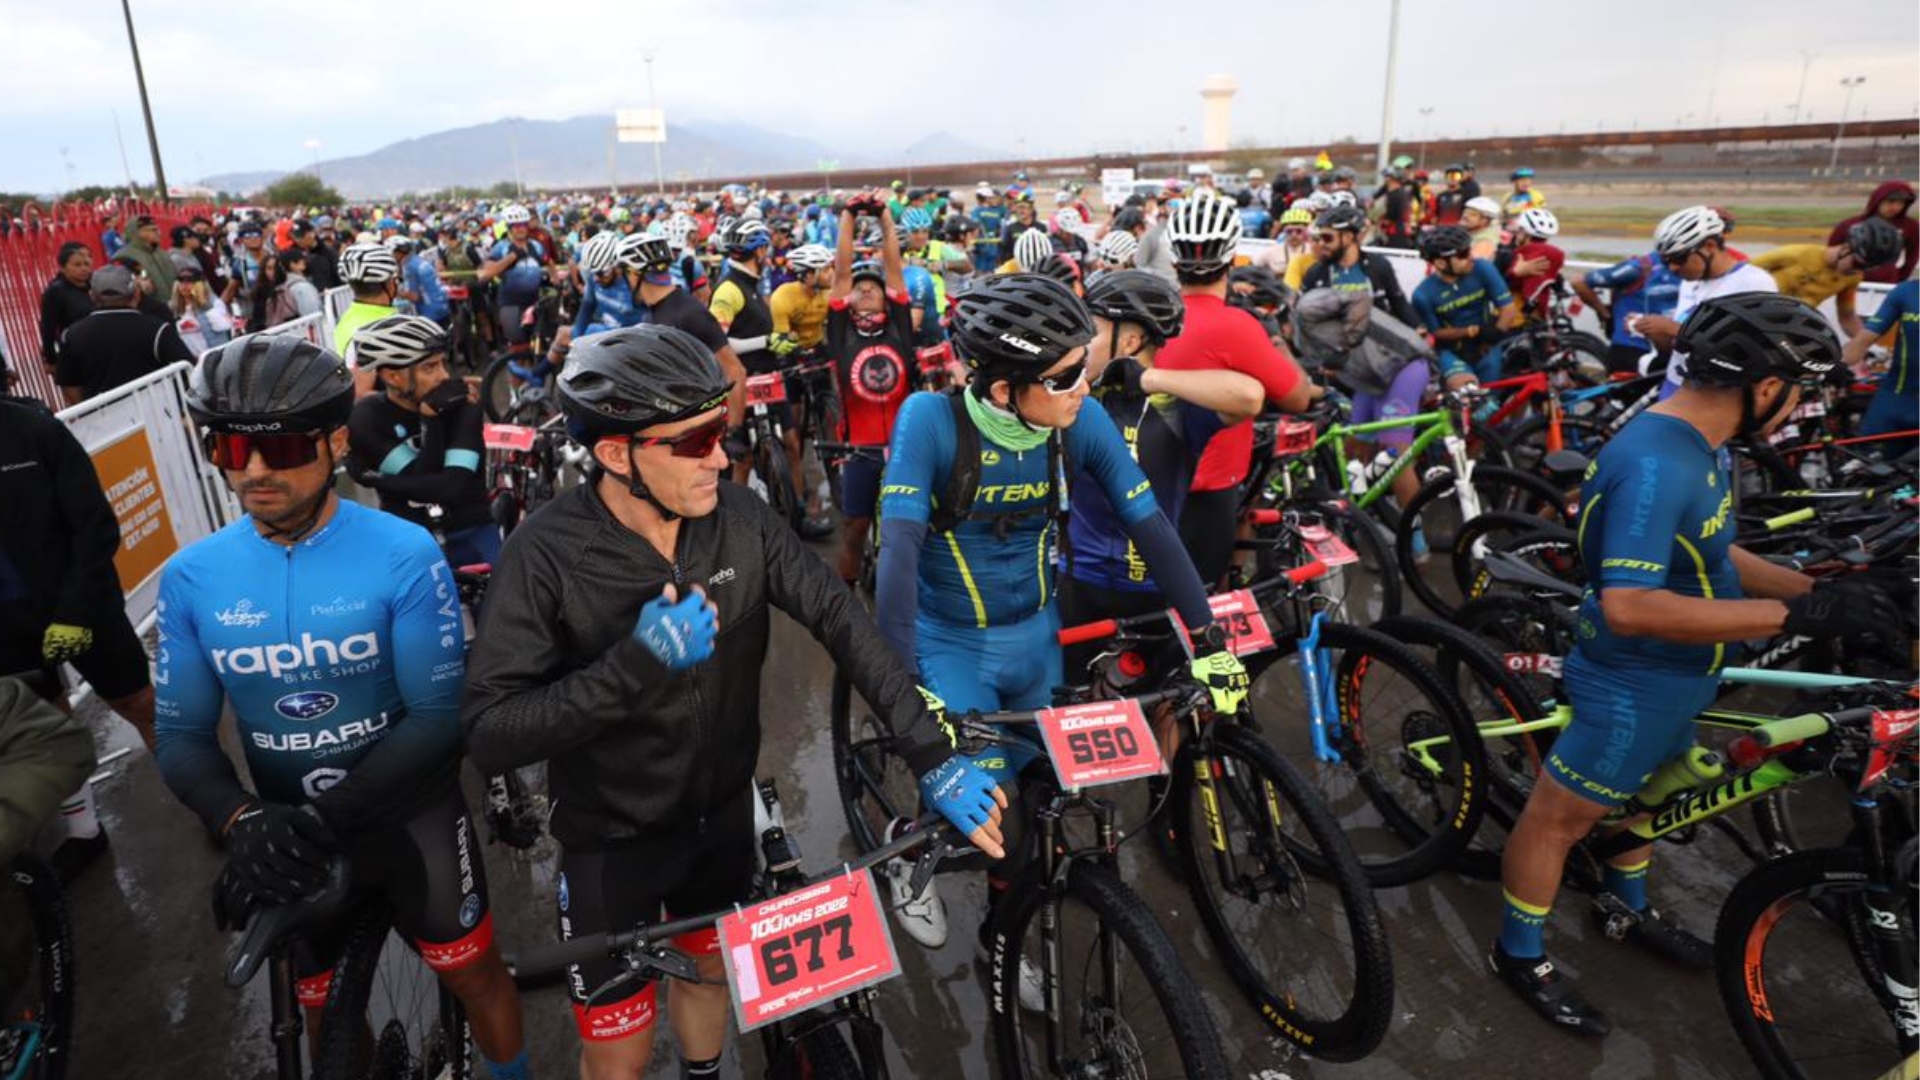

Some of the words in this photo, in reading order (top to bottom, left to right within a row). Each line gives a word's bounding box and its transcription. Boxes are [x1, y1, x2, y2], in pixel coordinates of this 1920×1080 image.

[211, 632, 379, 678] rapha
[283, 668, 322, 684] BIKE
[329, 658, 381, 678] SHOP
[252, 712, 389, 751] SUBARU
[1067, 726, 1139, 765] 550
[1651, 769, 1757, 834] GIANT
[456, 815, 475, 895] SUBARU
[814, 896, 849, 919] 2022
[760, 914, 856, 986] 677
[993, 933, 1006, 1014] MAXXIS
